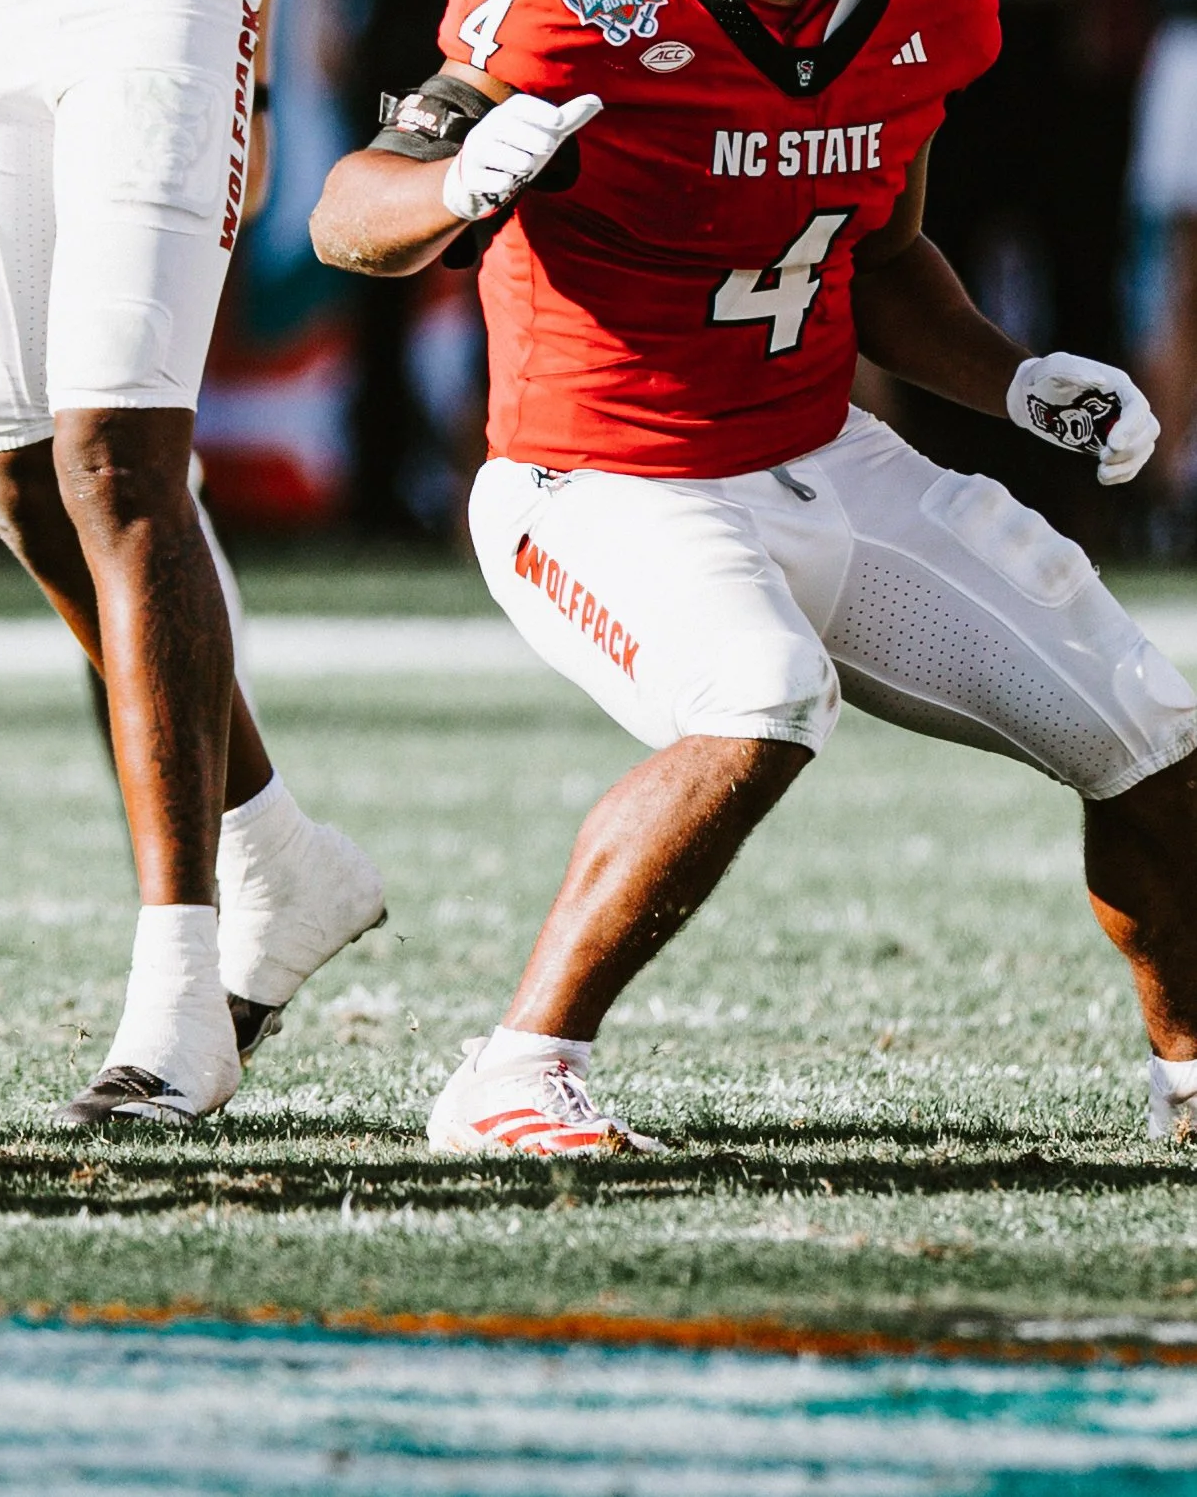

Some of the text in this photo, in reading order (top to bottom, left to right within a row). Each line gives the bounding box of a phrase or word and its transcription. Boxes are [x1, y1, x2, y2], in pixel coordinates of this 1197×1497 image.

[219, 0, 262, 253] WOLFPACK
[650, 49, 686, 61] ACC
[713, 122, 883, 177] NC STATE
[707, 206, 856, 359] 4
[514, 533, 639, 682] WOLFPACK
